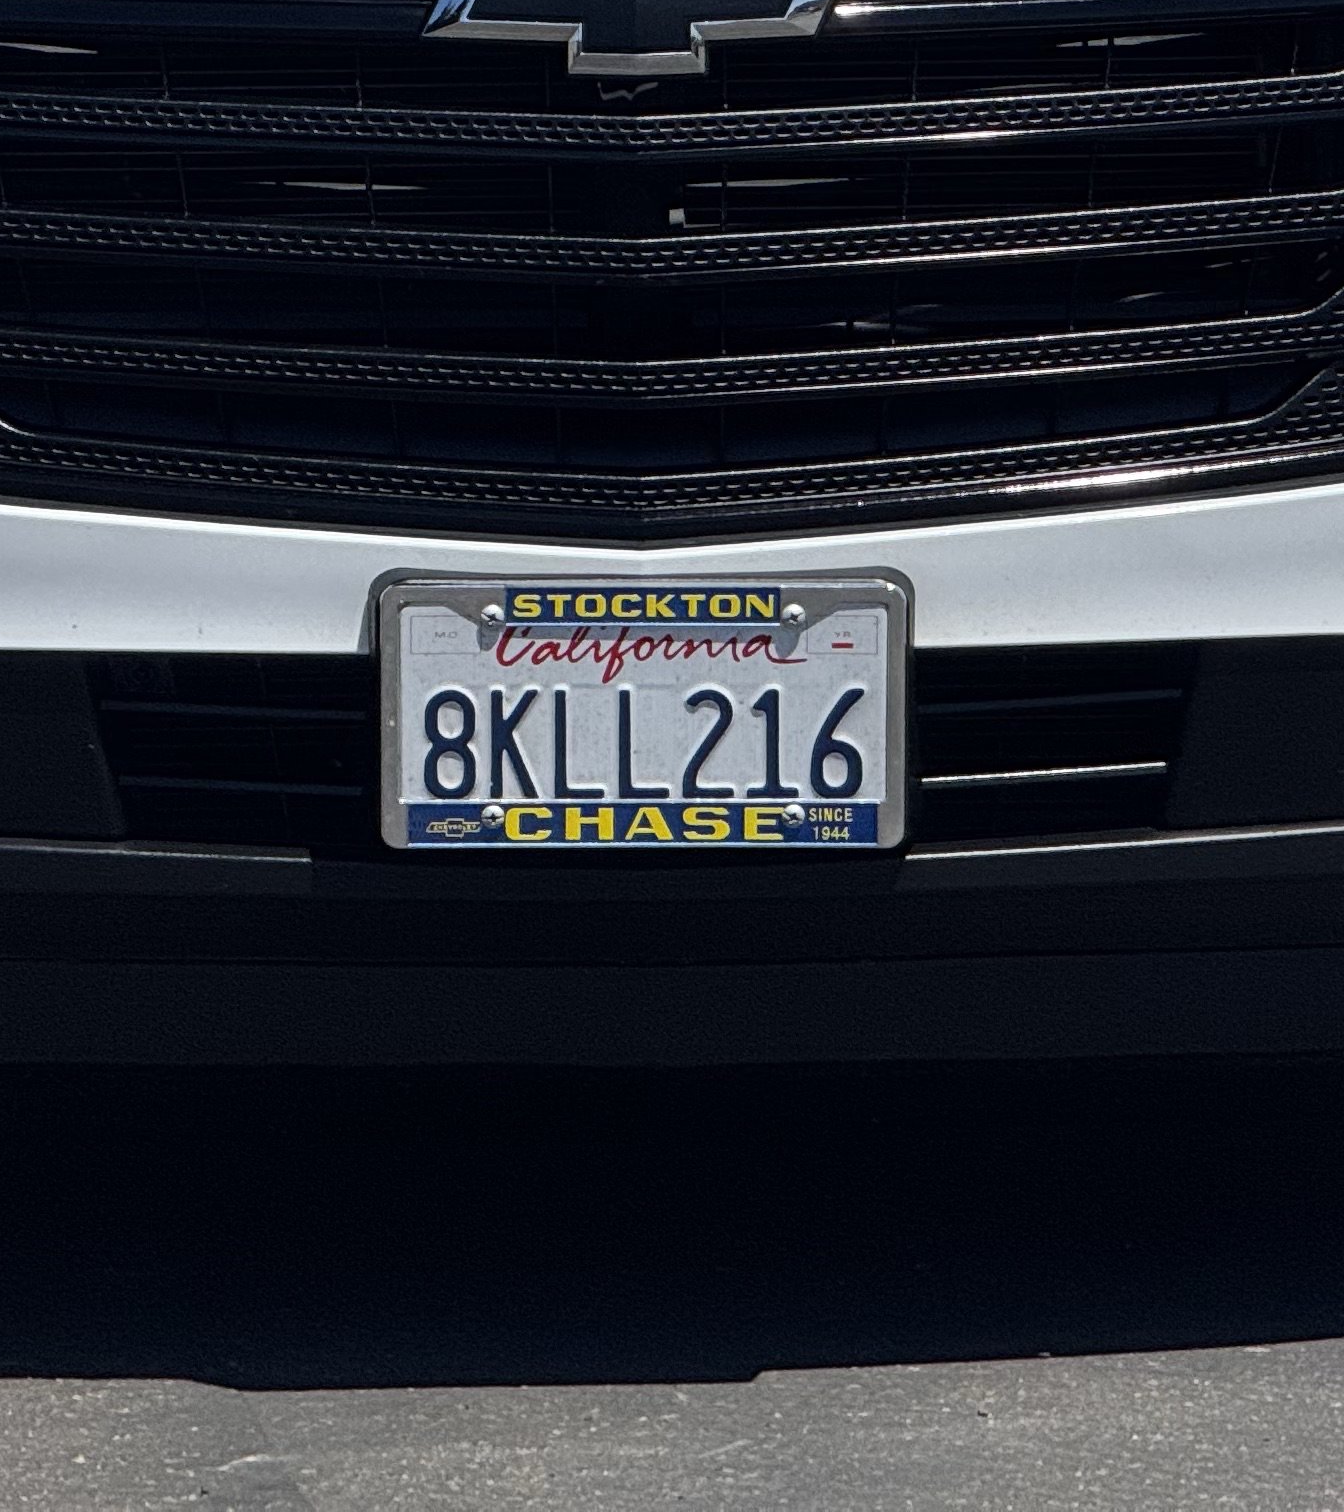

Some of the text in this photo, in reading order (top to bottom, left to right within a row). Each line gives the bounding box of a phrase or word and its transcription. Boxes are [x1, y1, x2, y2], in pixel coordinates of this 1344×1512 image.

[511, 593, 776, 619] STOCKTON
[495, 625, 808, 684] California
[423, 688, 865, 799] 8KLL216
[504, 806, 786, 841] CHASE
[808, 807, 854, 823] SINCE
[812, 825, 850, 841] 1944
